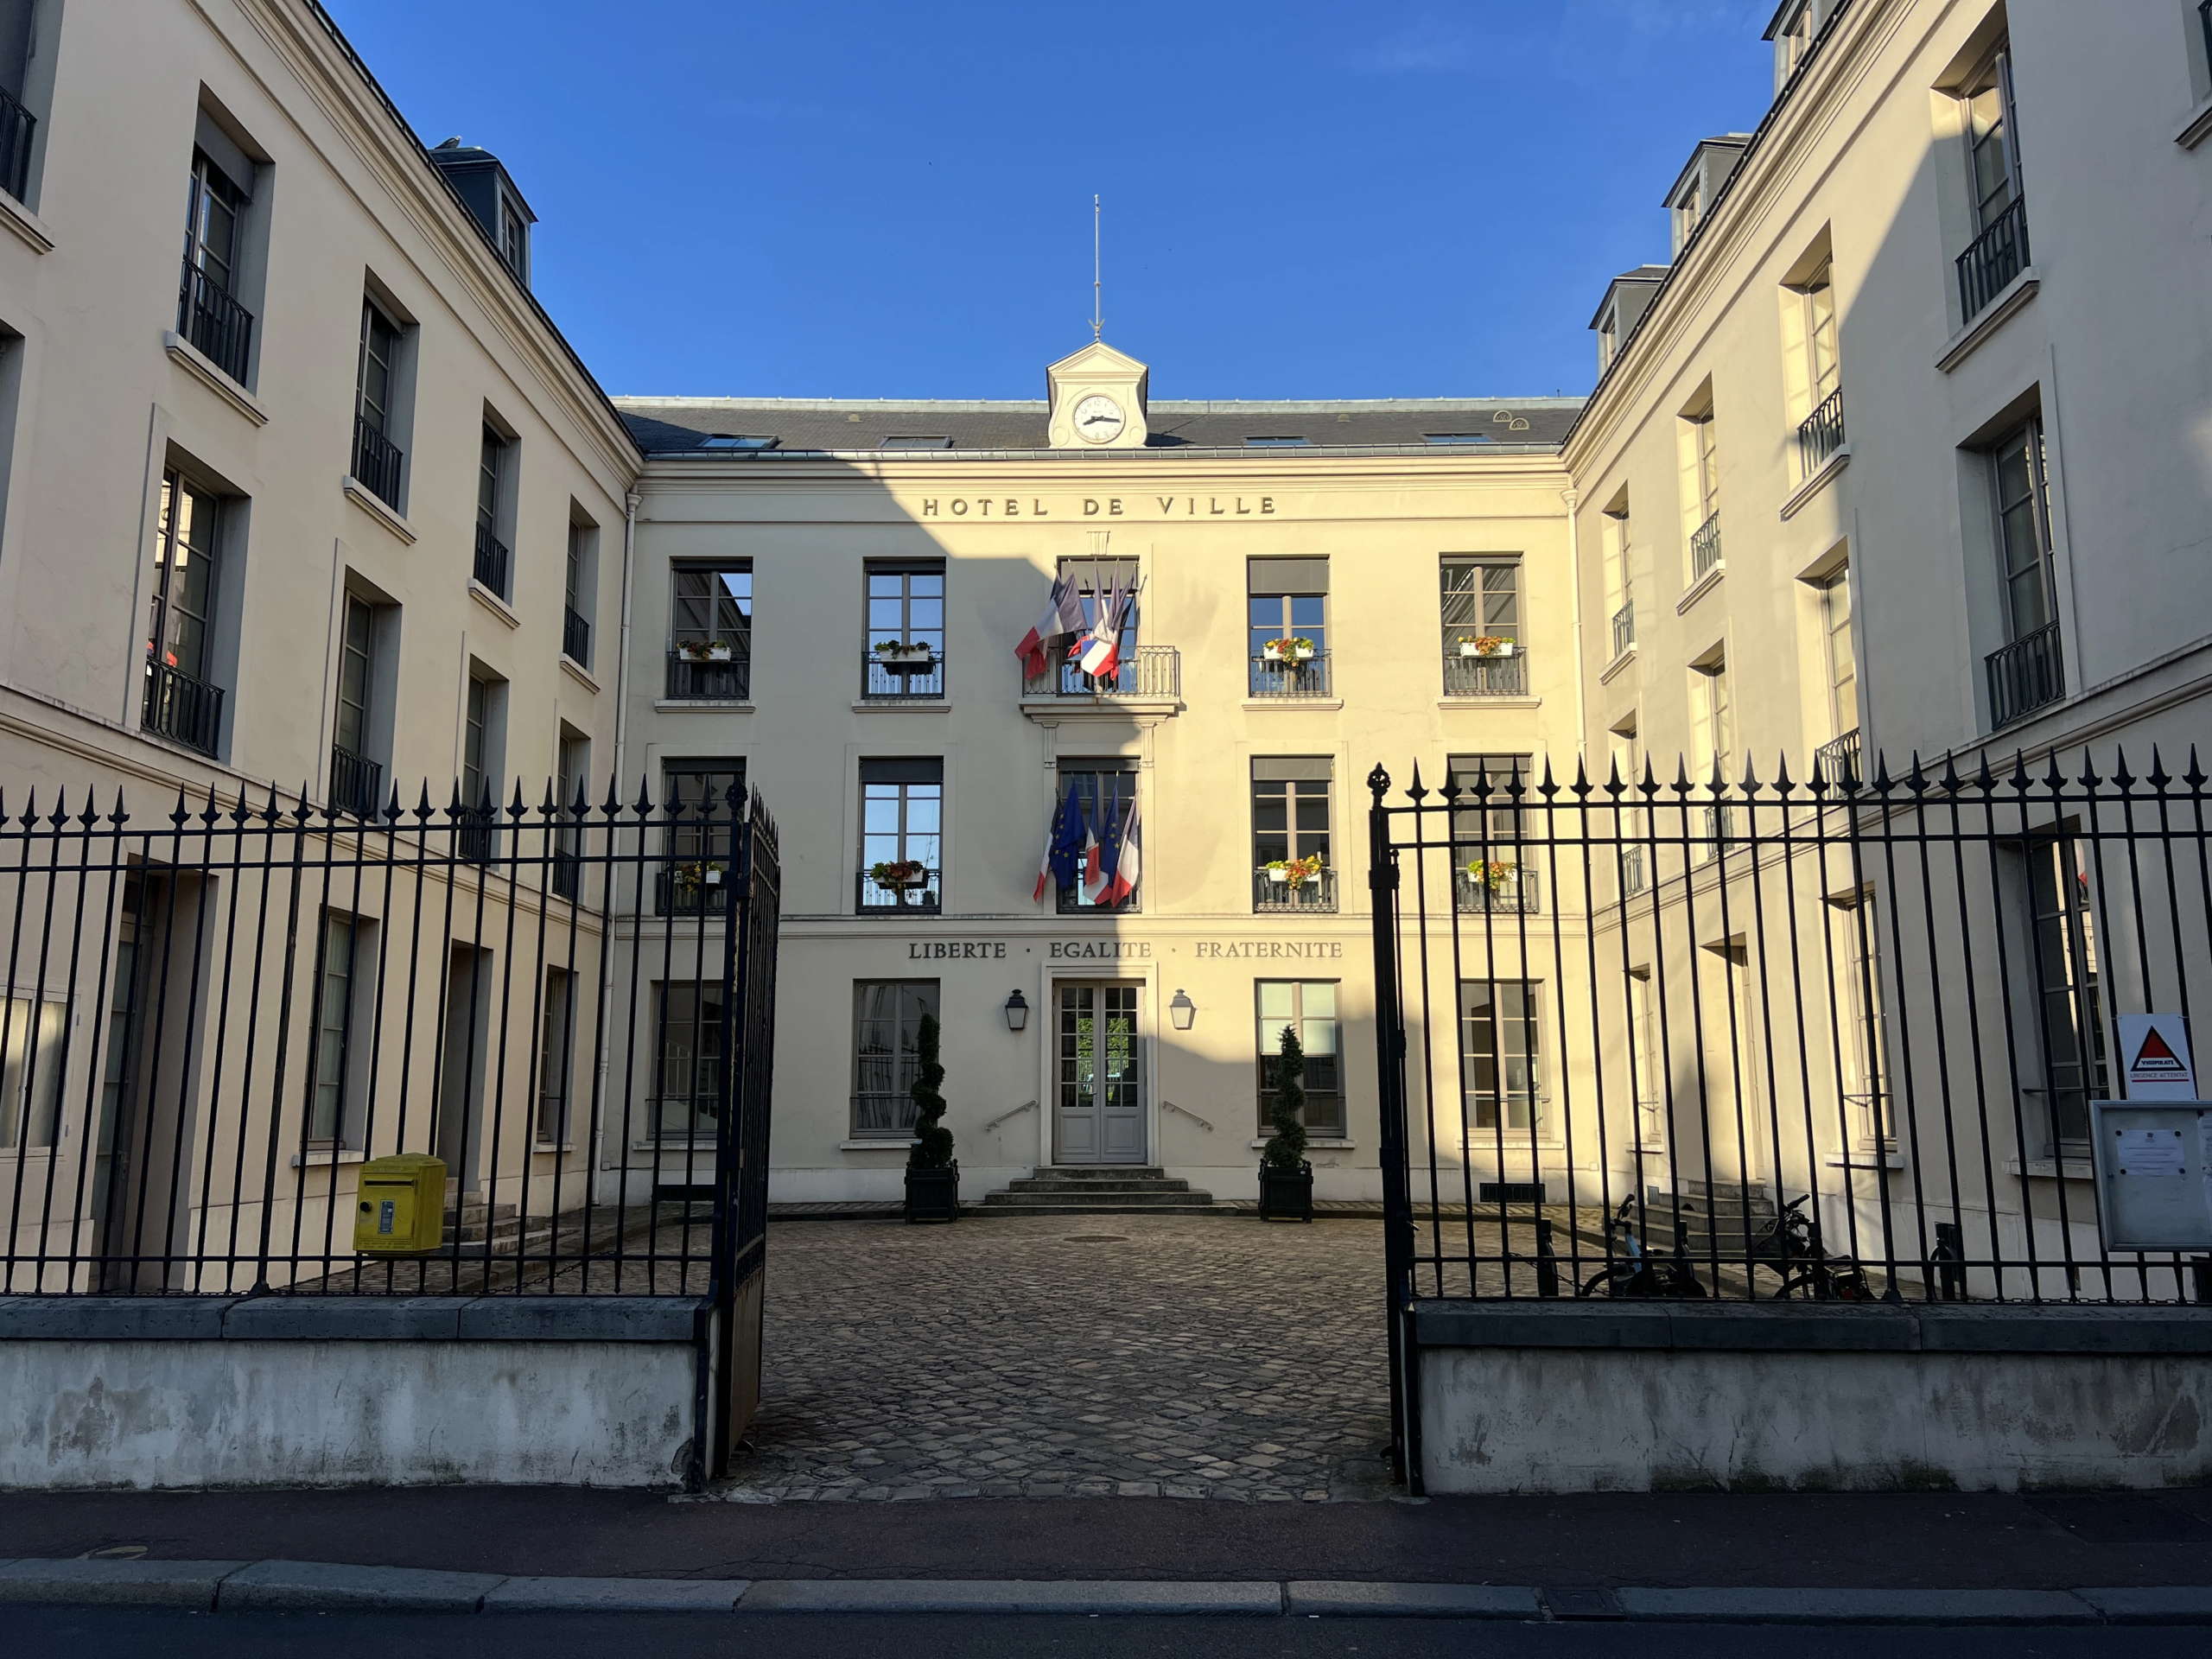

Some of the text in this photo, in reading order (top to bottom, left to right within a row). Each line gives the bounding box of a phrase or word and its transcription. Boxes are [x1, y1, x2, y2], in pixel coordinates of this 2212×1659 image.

[922, 497, 1276, 516] HOTEL DE VILLE
[908, 942, 1343, 959] LIBERTE EGALITE FRATERNITE
